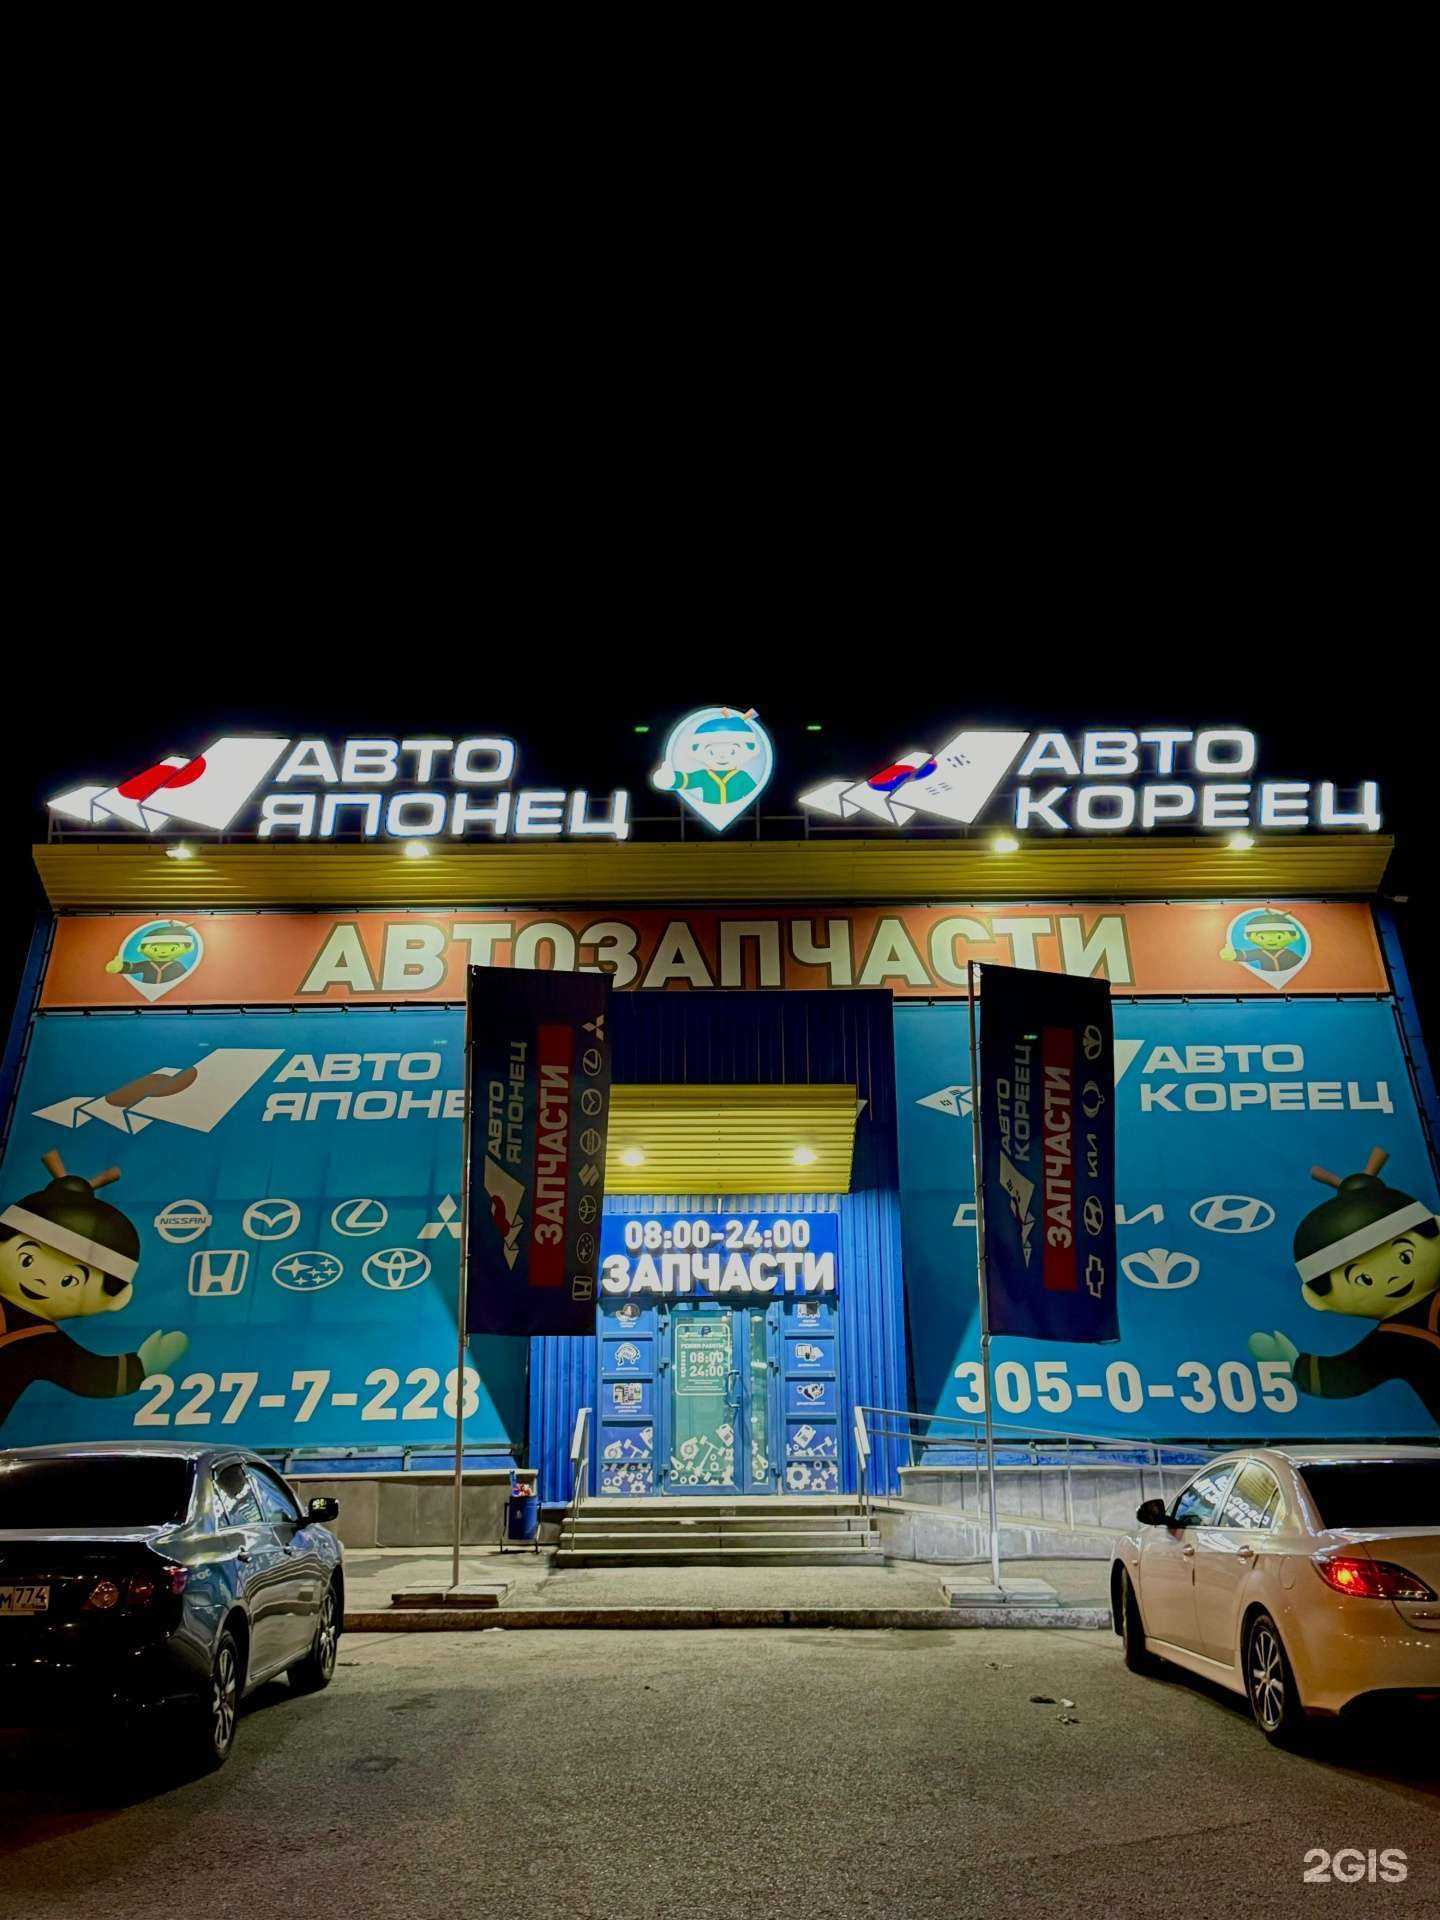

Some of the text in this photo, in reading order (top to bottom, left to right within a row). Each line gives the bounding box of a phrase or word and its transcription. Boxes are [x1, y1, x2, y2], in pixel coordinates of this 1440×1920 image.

[274, 738, 515, 784] АВТО
[1017, 730, 1256, 776] АВТО
[258, 790, 629, 841] ЯПОНЕЦ
[1015, 782, 1381, 831] КОРЕЕЦ
[298, 917, 1133, 993] АВТОЗАПЧАСТИ
[273, 1051, 441, 1083] АВТО
[1142, 1043, 1304, 1073] АВТО
[262, 1090, 466, 1122] ЯПОНЕ
[487, 1080, 504, 1157] АВТО
[505, 1041, 528, 1165] ЯПОНЕЦ
[996, 1078, 1011, 1152] АВТО
[1013, 1044, 1032, 1163] КОРЕЕЦ
[1140, 1081, 1394, 1114] КОРЕЕЦ
[534, 1065, 569, 1246] ЗАПЧАСТИ
[1043, 1066, 1072, 1249] ЗАПЧАСТИ
[160, 1216, 207, 1225] NISSAN
[624, 1219, 811, 1249] 08:00-24:00
[601, 1252, 835, 1293] ЗАПЧАСТИ
[133, 1367, 481, 1427] 227-7-228
[953, 1361, 1298, 1414] 305-0-305
